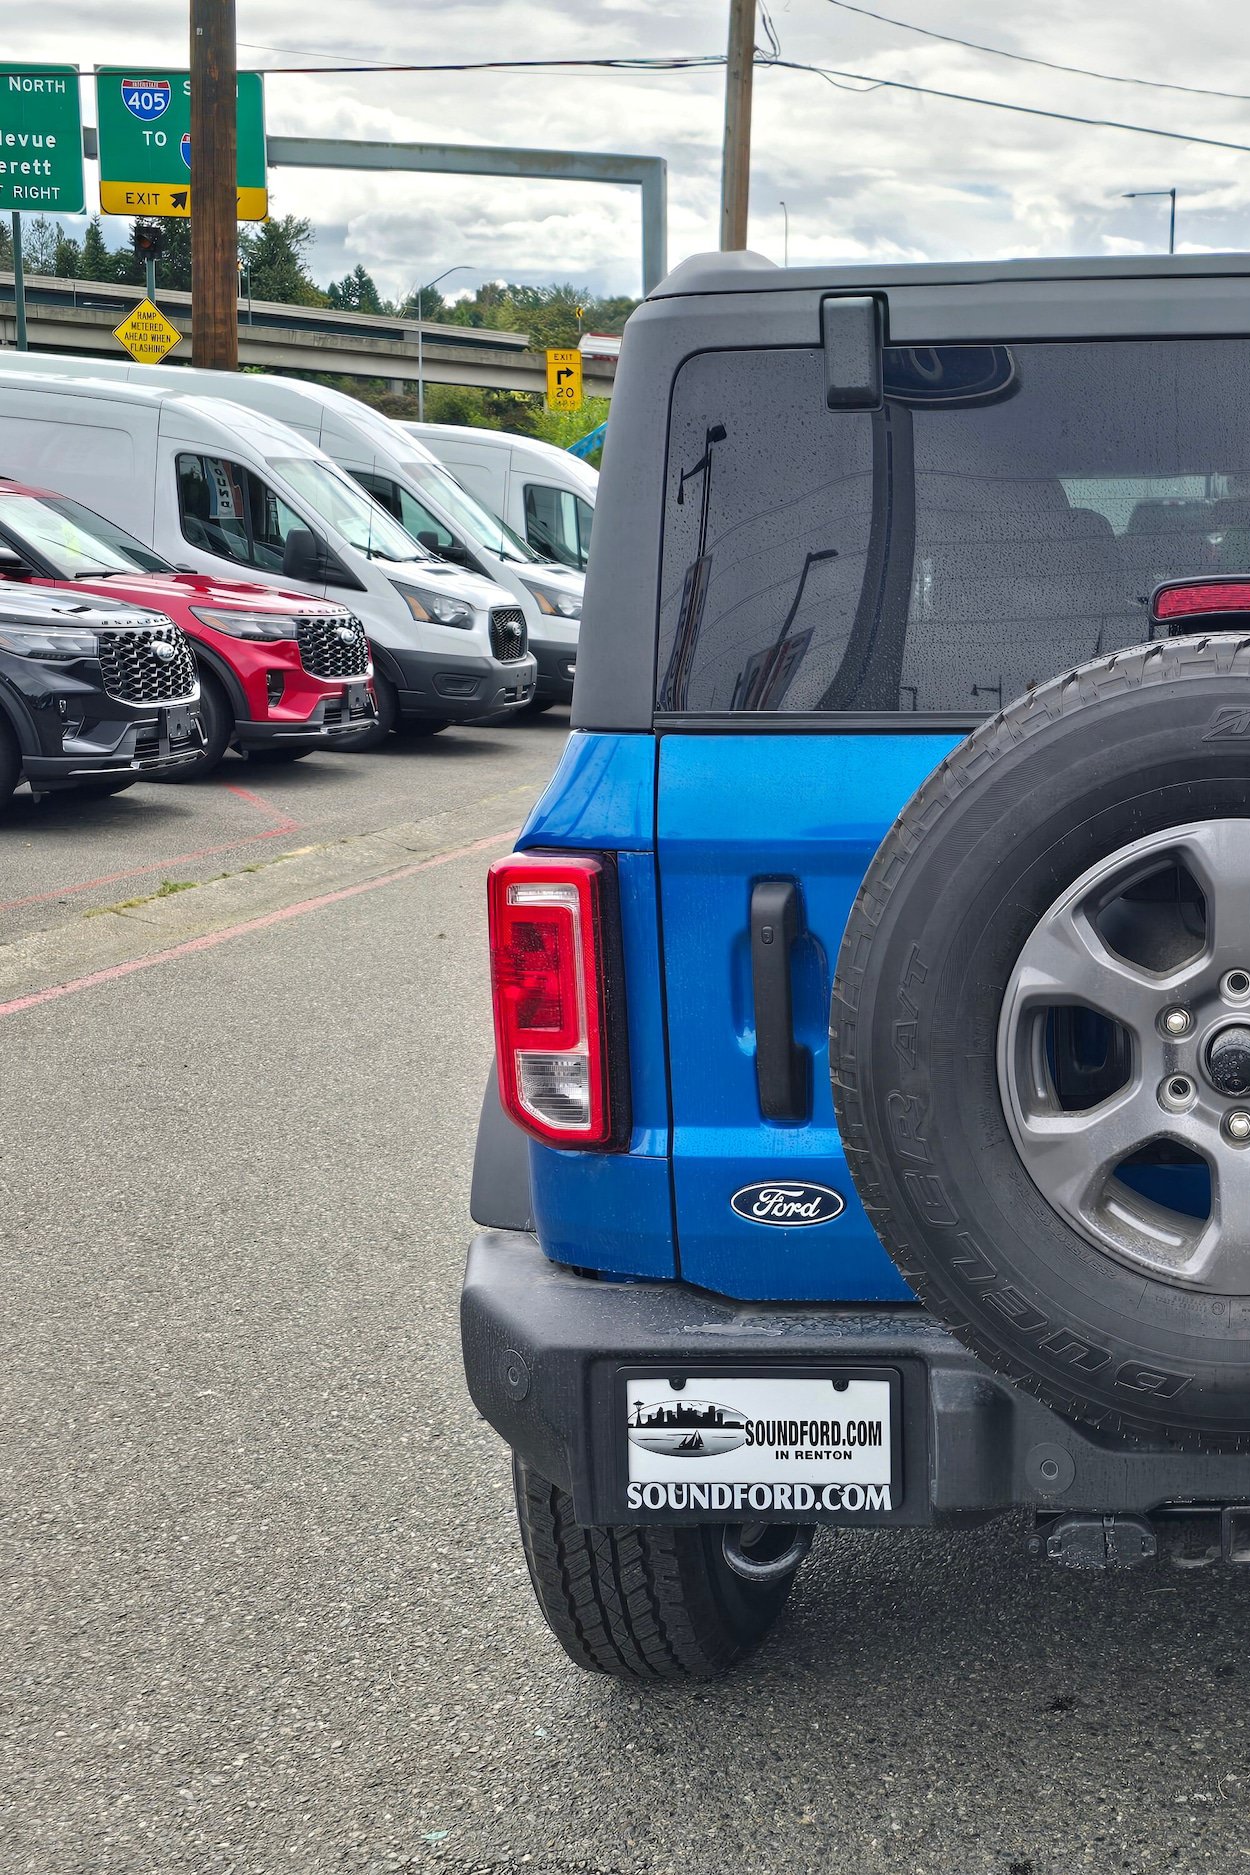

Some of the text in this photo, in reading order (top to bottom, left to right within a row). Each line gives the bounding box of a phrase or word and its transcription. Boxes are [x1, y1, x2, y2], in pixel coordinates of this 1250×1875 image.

[8, 75, 66, 94] NORTH
[128, 92, 166, 111] 405
[142, 131, 168, 147] TO
[0, 159, 52, 176] erett
[13, 185, 61, 200] RIGHT
[125, 191, 161, 206] EXIT
[136, 311, 157, 321] RAMP
[130, 321, 164, 332] METERED
[124, 332, 171, 343] AHEAD WHEN
[130, 342, 165, 354] FLASHING
[553, 353, 573, 361] EXIT
[556, 387, 575, 398] 20
[752, 1188, 822, 1218] Ford
[745, 1420, 882, 1447] SOUNDFORD.COM
[775, 1450, 853, 1460] IN RENTON
[626, 1482, 893, 1512] SOUNDFORD.COM
